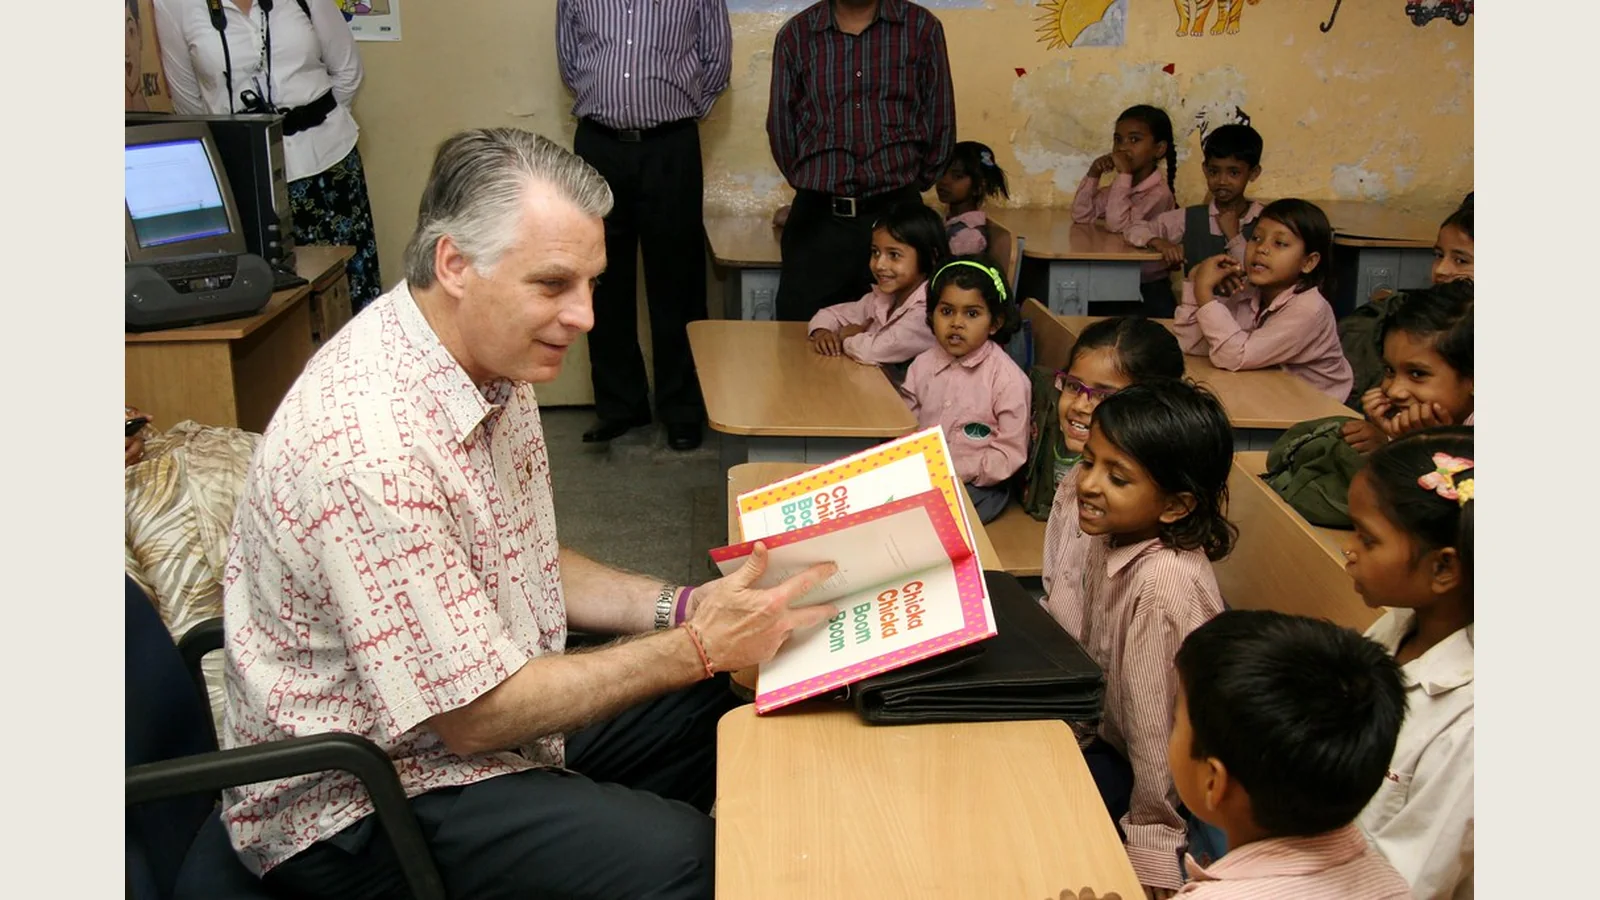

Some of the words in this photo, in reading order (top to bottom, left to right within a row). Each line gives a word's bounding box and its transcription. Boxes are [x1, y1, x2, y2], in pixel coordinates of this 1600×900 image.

[798, 497, 814, 527] Boo
[815, 493, 834, 520] Chi
[832, 486, 850, 519] Chic
[853, 602, 871, 644] Boom
[877, 589, 900, 639] Chicka
[902, 581, 926, 630] Chicka
[828, 611, 846, 653] Boom
